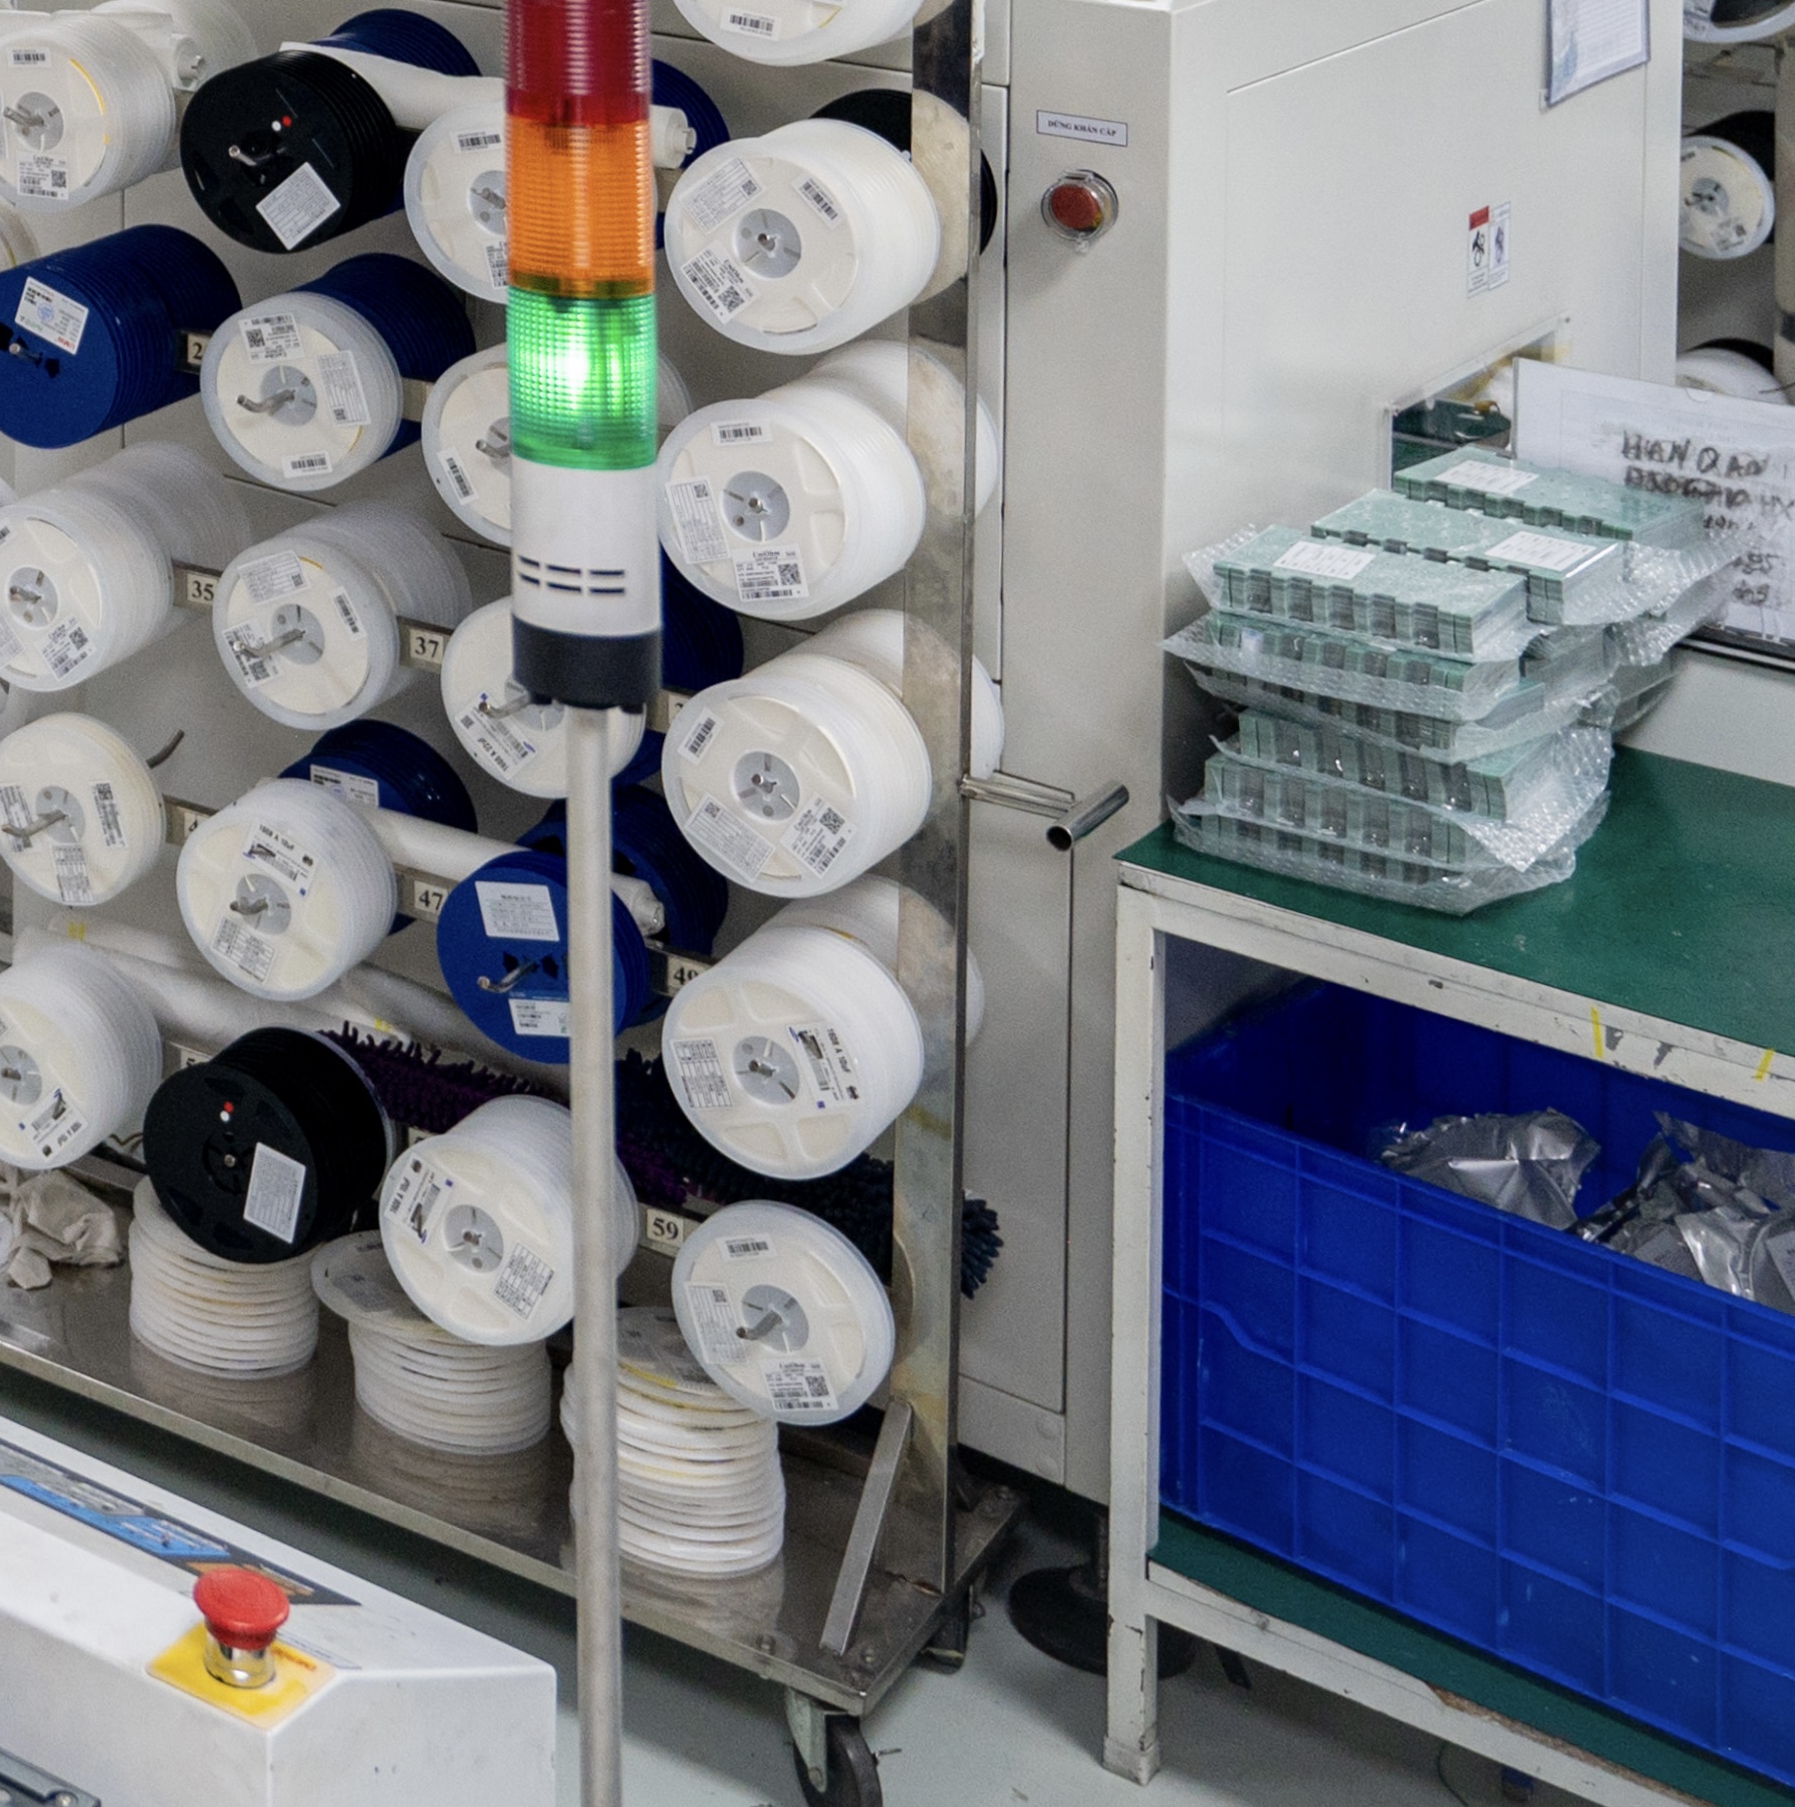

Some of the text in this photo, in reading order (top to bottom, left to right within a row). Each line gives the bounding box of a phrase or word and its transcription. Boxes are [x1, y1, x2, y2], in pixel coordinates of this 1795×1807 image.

[191, 579, 214, 606] 35
[414, 636, 439, 658] 37
[419, 890, 443, 912] 47
[652, 1217, 678, 1240] 59
